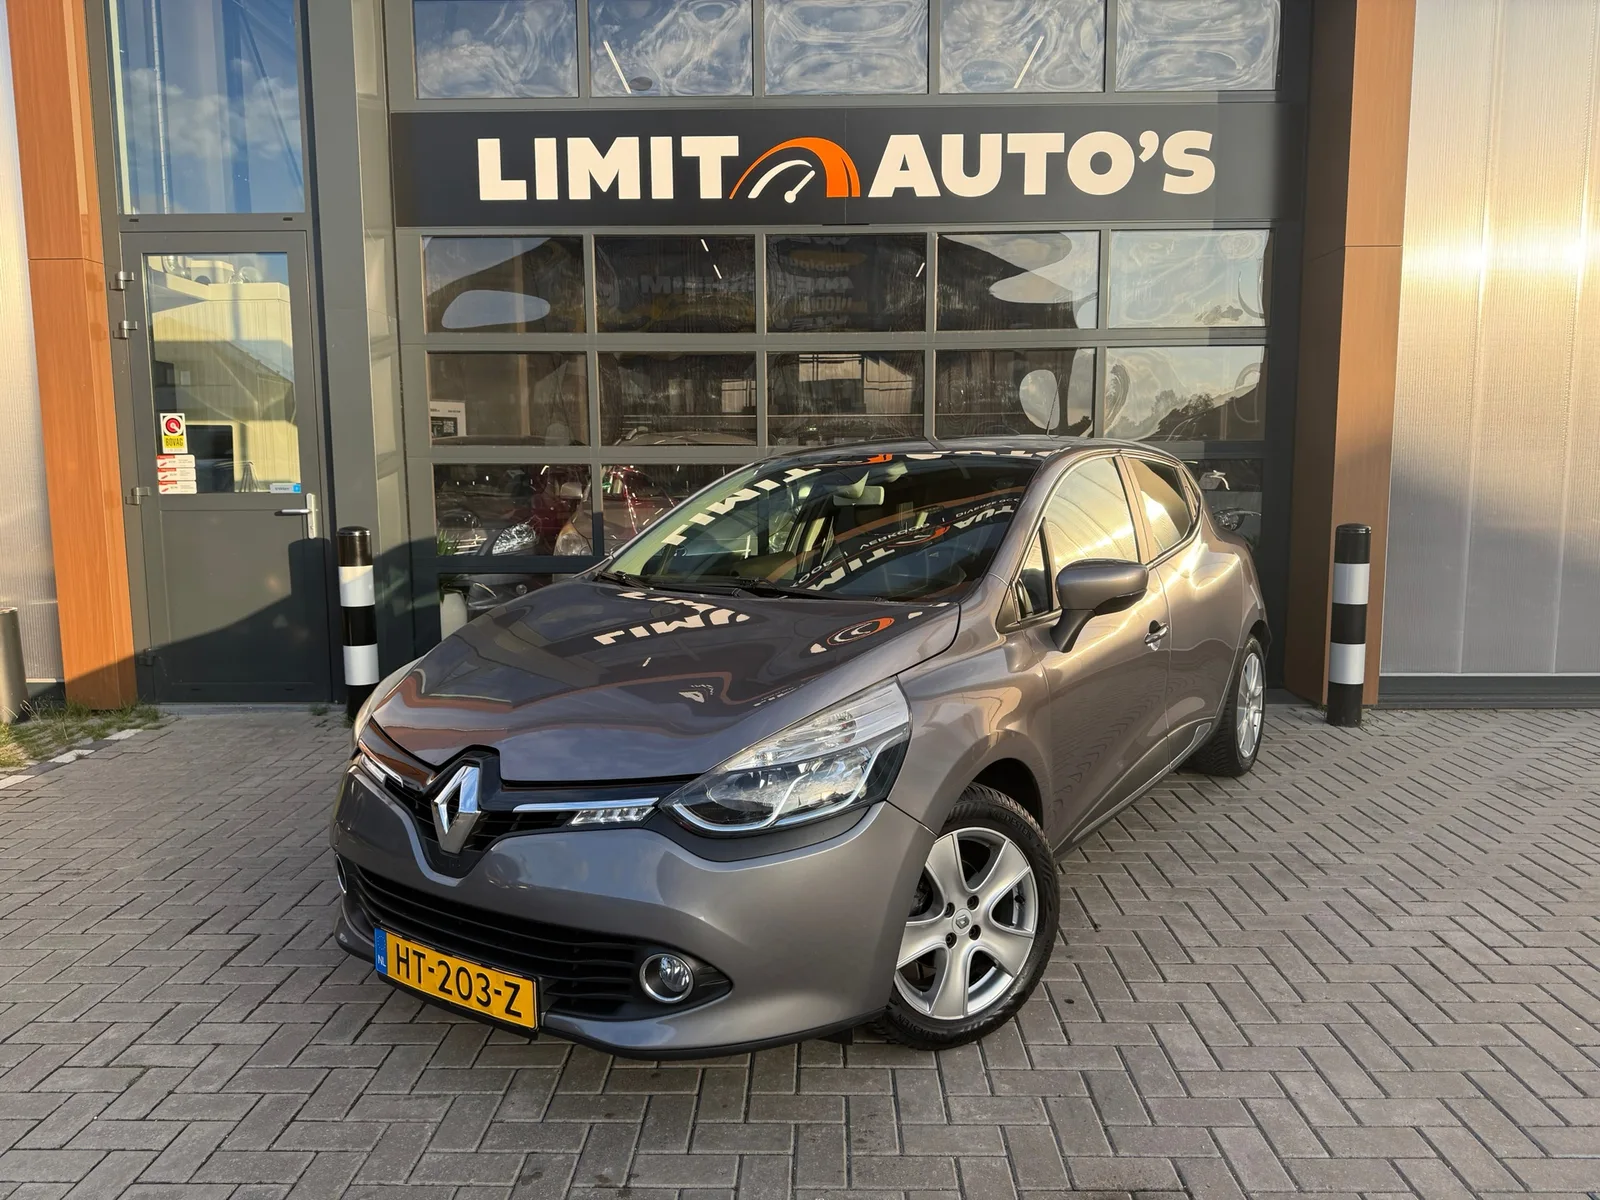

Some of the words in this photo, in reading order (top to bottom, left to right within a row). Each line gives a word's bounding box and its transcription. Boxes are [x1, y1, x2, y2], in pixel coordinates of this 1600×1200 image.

[477, 135, 739, 201] LIMIT
[867, 130, 1216, 198] AUTO'S
[165, 437, 184, 447] BOVAG
[377, 954, 387, 967] NL
[396, 943, 522, 1018] HT-203-Z
